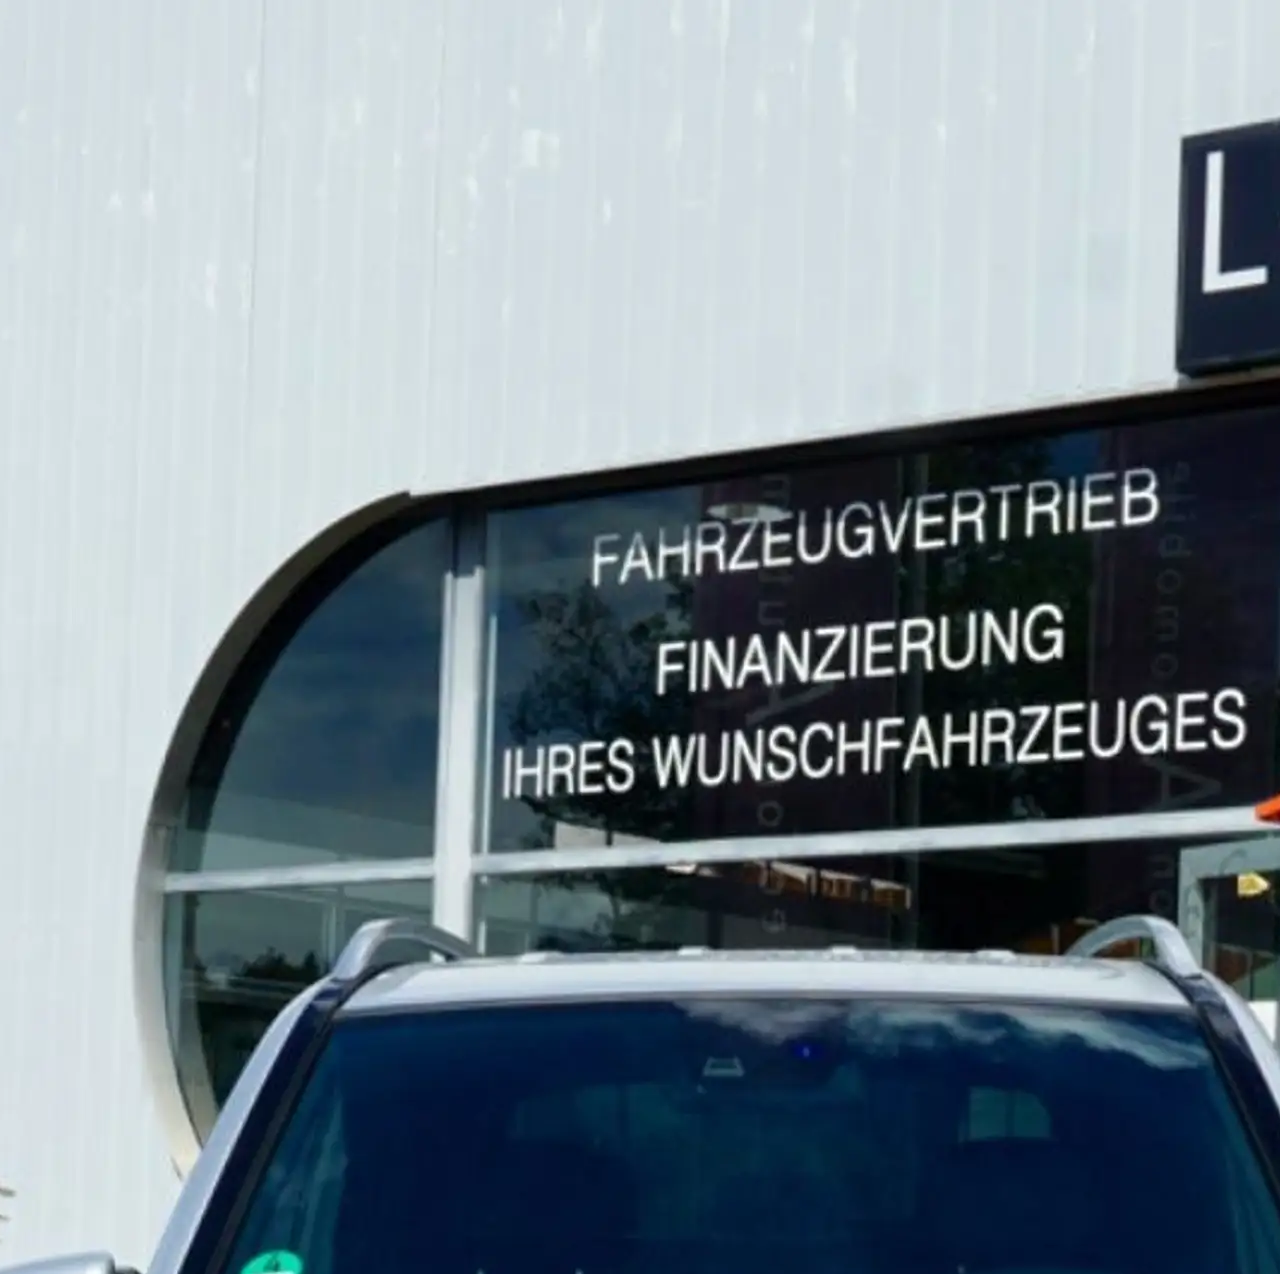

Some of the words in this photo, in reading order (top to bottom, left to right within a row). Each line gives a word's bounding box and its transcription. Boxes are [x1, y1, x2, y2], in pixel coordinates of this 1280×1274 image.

[592, 468, 1160, 588] FAHRZEUGVERTRIEB
[656, 603, 1065, 696] FINANZIERUNG
[502, 736, 636, 800] IHRES
[652, 687, 1247, 789] WUNSCHFAHRZEUGES
